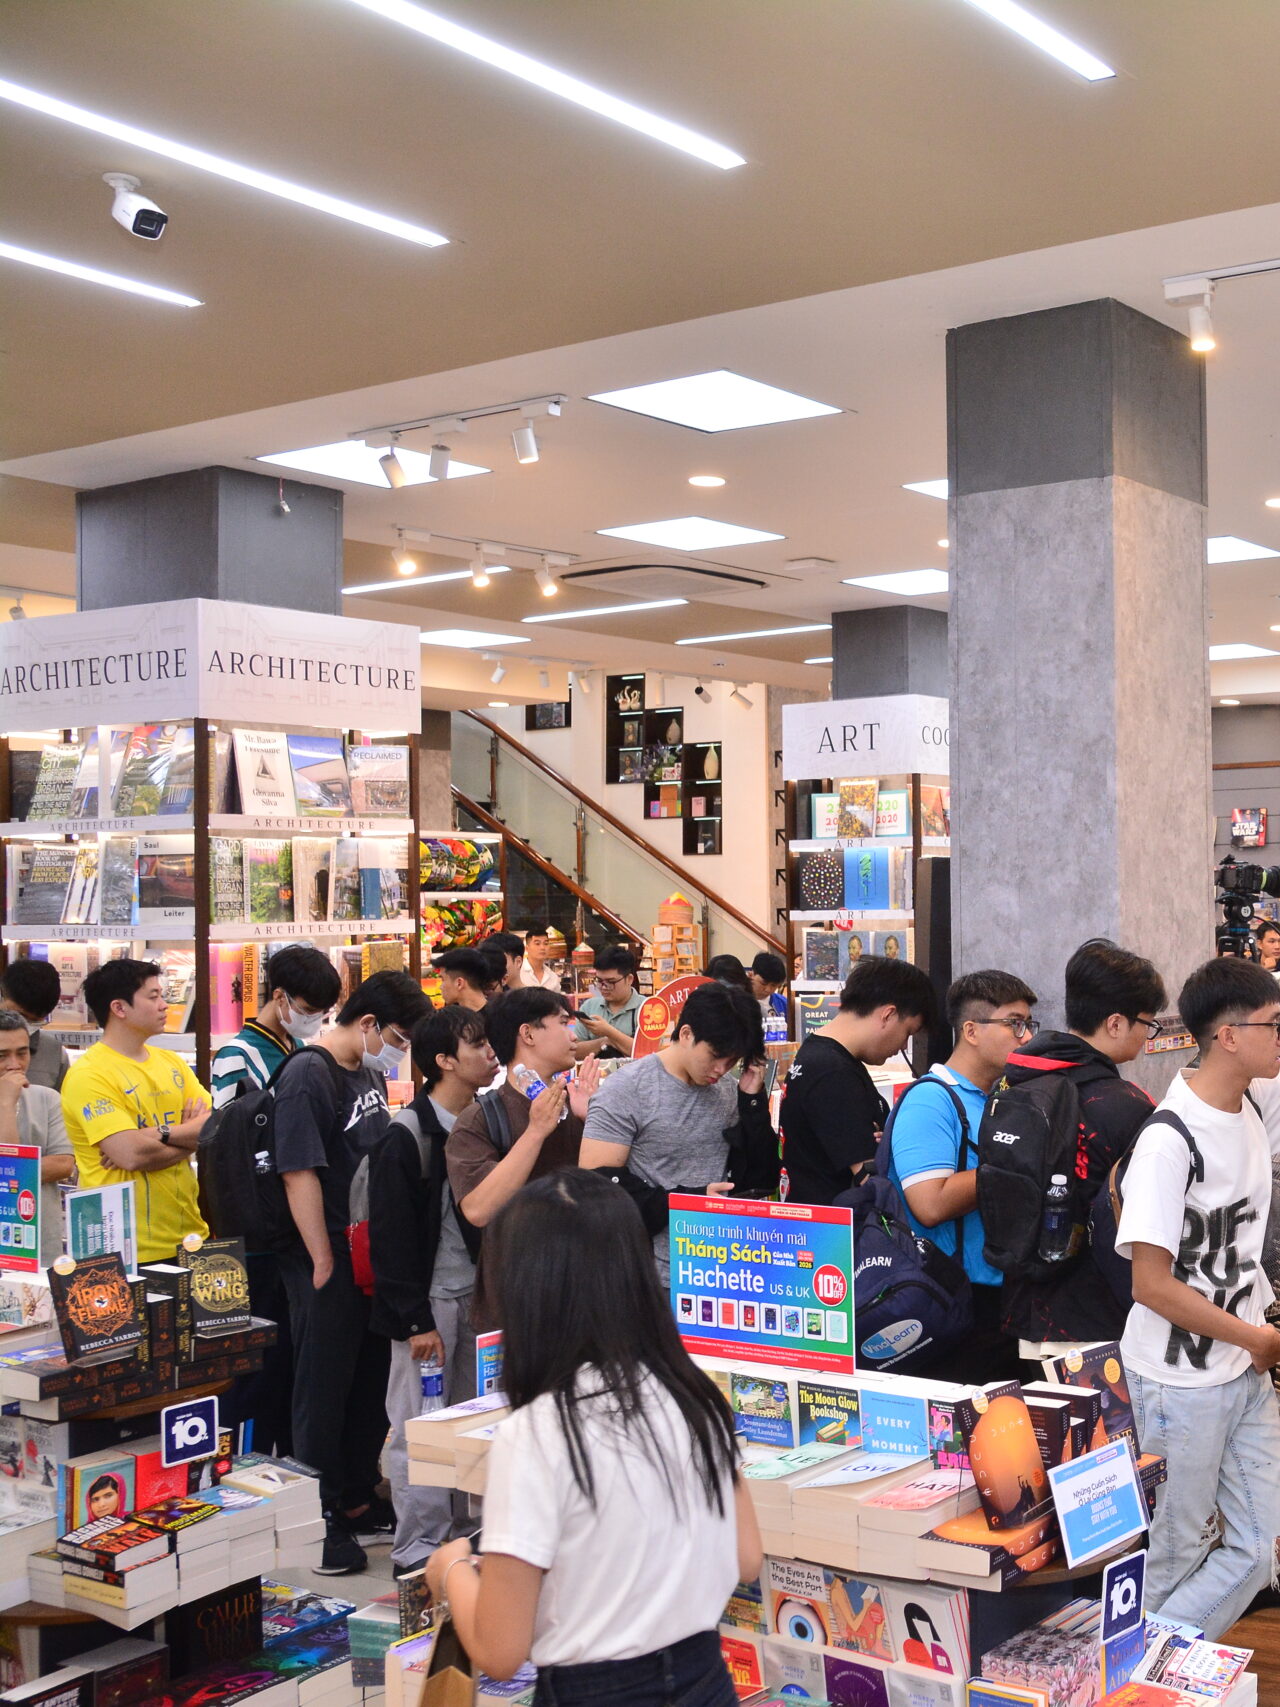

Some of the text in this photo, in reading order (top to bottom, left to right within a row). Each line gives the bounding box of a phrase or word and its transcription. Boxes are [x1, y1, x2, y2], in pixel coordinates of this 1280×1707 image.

[1, 648, 188, 696] ARCHITECTURE
[208, 650, 416, 691] ARCHITECTURE
[817, 723, 880, 753] ART
[353, 751, 402, 761] RECLAIMED
[51, 819, 136, 832] ARCHITECTURE
[253, 818, 376, 830] ARCHITECTURE
[1233, 829, 1258, 837] WARS
[835, 839, 865, 848] ART
[164, 909, 185, 917] Leiter
[835, 910, 866, 920] ART
[51, 927, 137, 937] ARCHITECTURE
[254, 923, 376, 935] ARCHITECTURE
[244, 943, 254, 1003] WALTER GROPIUS
[669, 987, 690, 1007] ART
[54, 1033, 101, 1043] ARCHITE
[993, 1130, 1020, 1145] acer
[675, 1219, 715, 1239] Chương
[717, 1225, 743, 1240] trình
[675, 1237, 772, 1265] Tháng Sách
[678, 1261, 810, 1298] Hachette US & UK
[75, 1281, 121, 1307] IRON
[196, 1282, 244, 1302] WING
[833, 1290, 844, 1299] OFF
[197, 1315, 250, 1327] REBECCA YARROS
[80, 1331, 141, 1351] REBECCA YARROS
[800, 1389, 858, 1411] The Moon Glow
[810, 1405, 849, 1425] Bookshop
[876, 1416, 911, 1430] EVERY
[871, 1439, 919, 1454] MOMENT
[841, 1464, 898, 1473] LOVE
[1104, 1473, 1118, 1484] Sách
[771, 1562, 821, 1582] The Eyes Are
[771, 1572, 823, 1593] the Best Part
